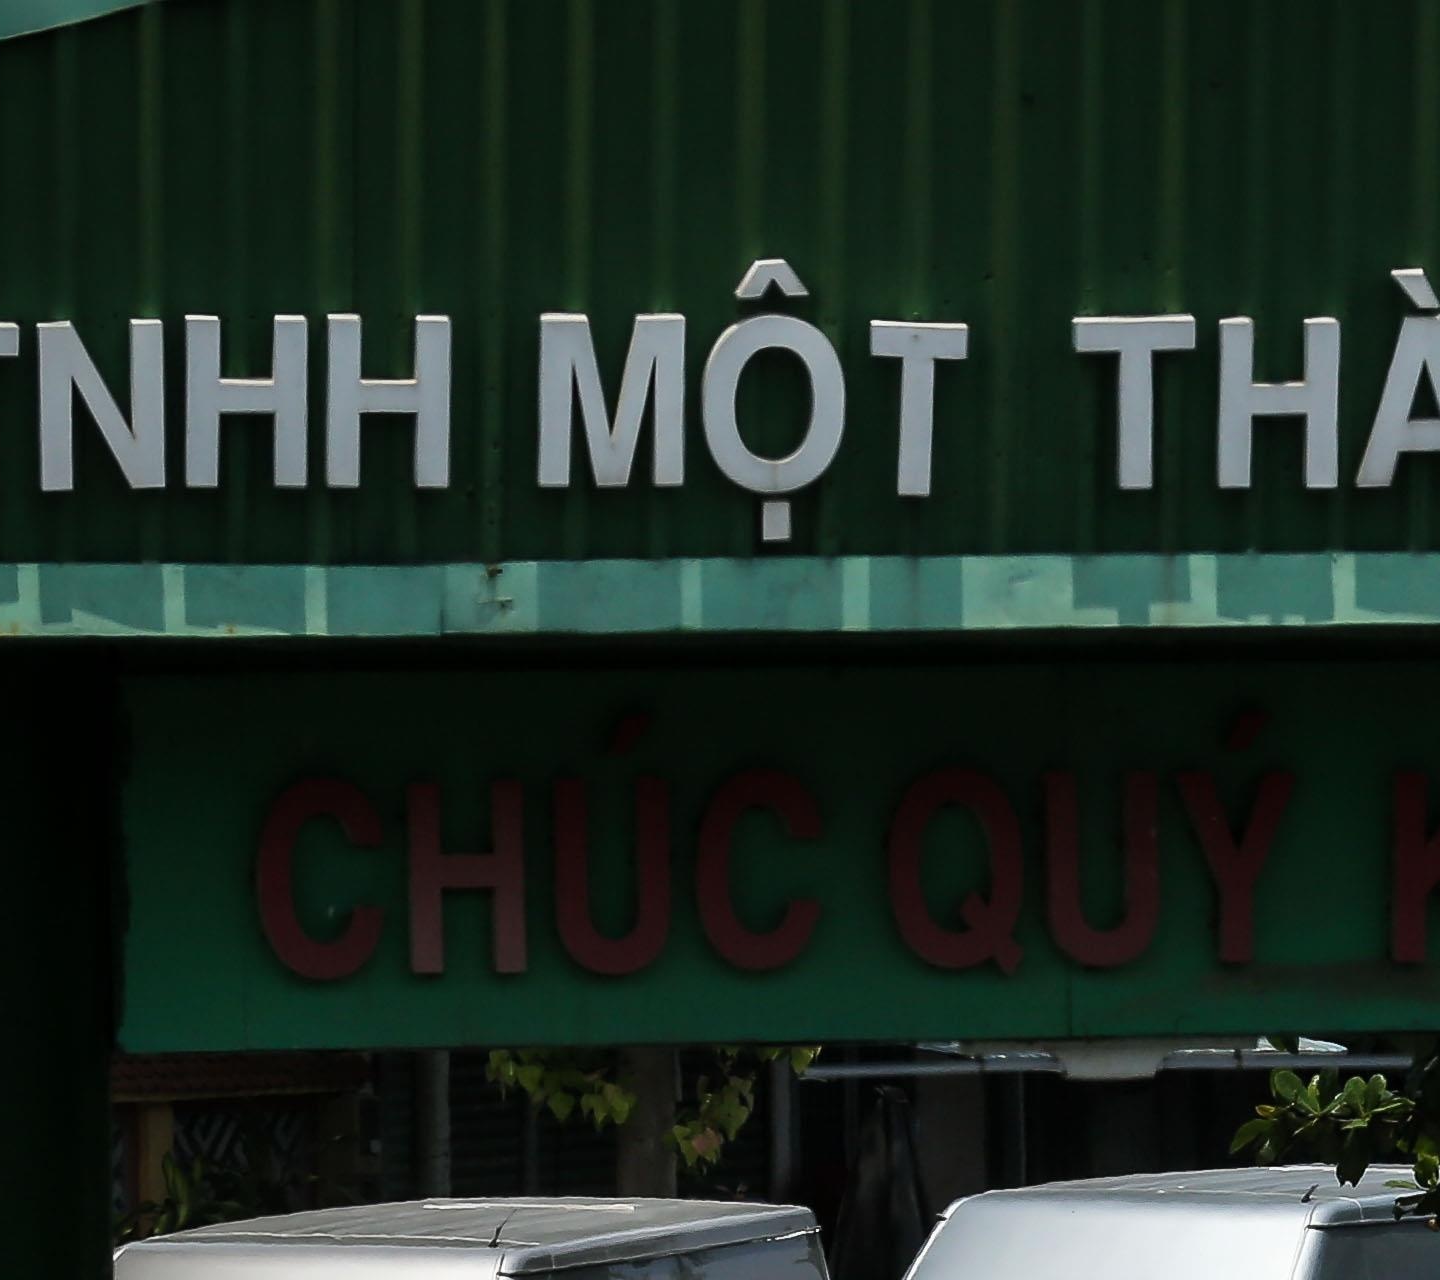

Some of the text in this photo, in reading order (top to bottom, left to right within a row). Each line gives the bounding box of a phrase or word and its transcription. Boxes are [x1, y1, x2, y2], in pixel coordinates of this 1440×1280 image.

[539, 259, 968, 540] MỘT
[254, 705, 824, 982] CHÚC
[888, 704, 1292, 978] QUÝ
